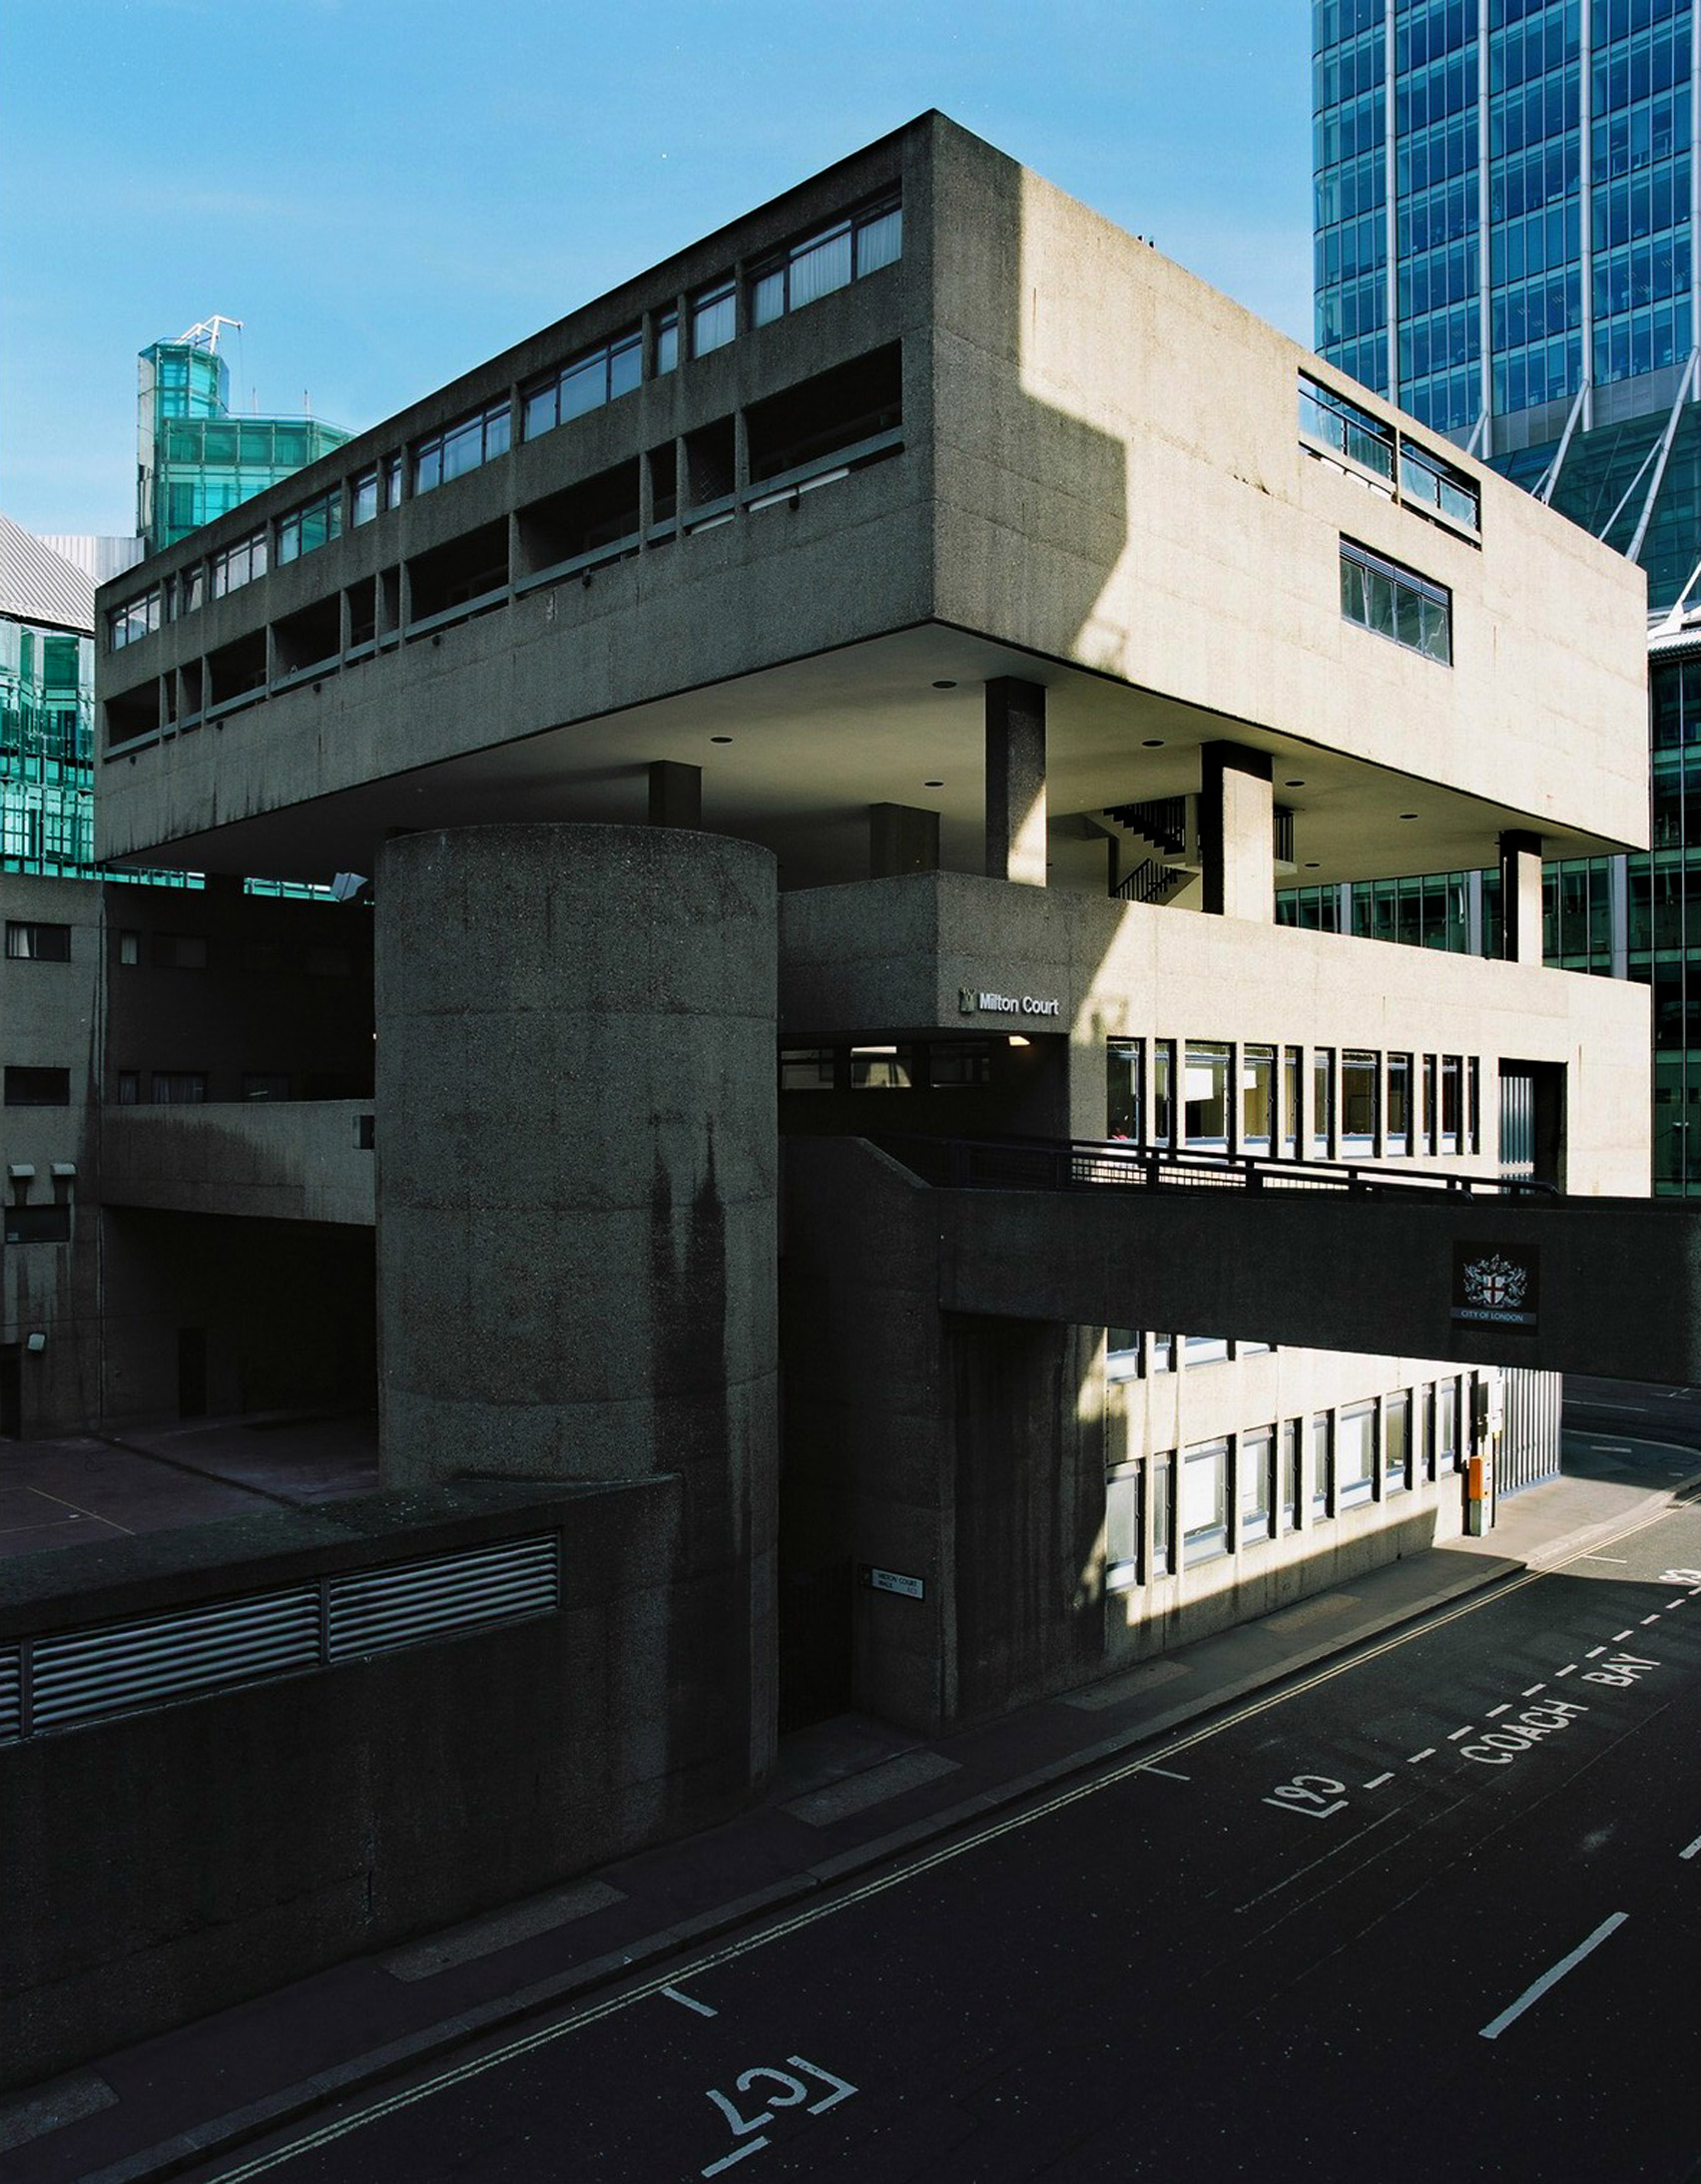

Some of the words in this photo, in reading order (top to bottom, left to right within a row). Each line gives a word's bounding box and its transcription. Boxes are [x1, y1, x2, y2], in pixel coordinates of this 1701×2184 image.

[979, 992, 1018, 1012] Milton
[1022, 996, 1059, 1015] Court
[1490, 1312, 1523, 1322] LONDON
[1459, 1699, 1589, 1766] COACH
[1581, 1652, 1661, 1688] BAY
